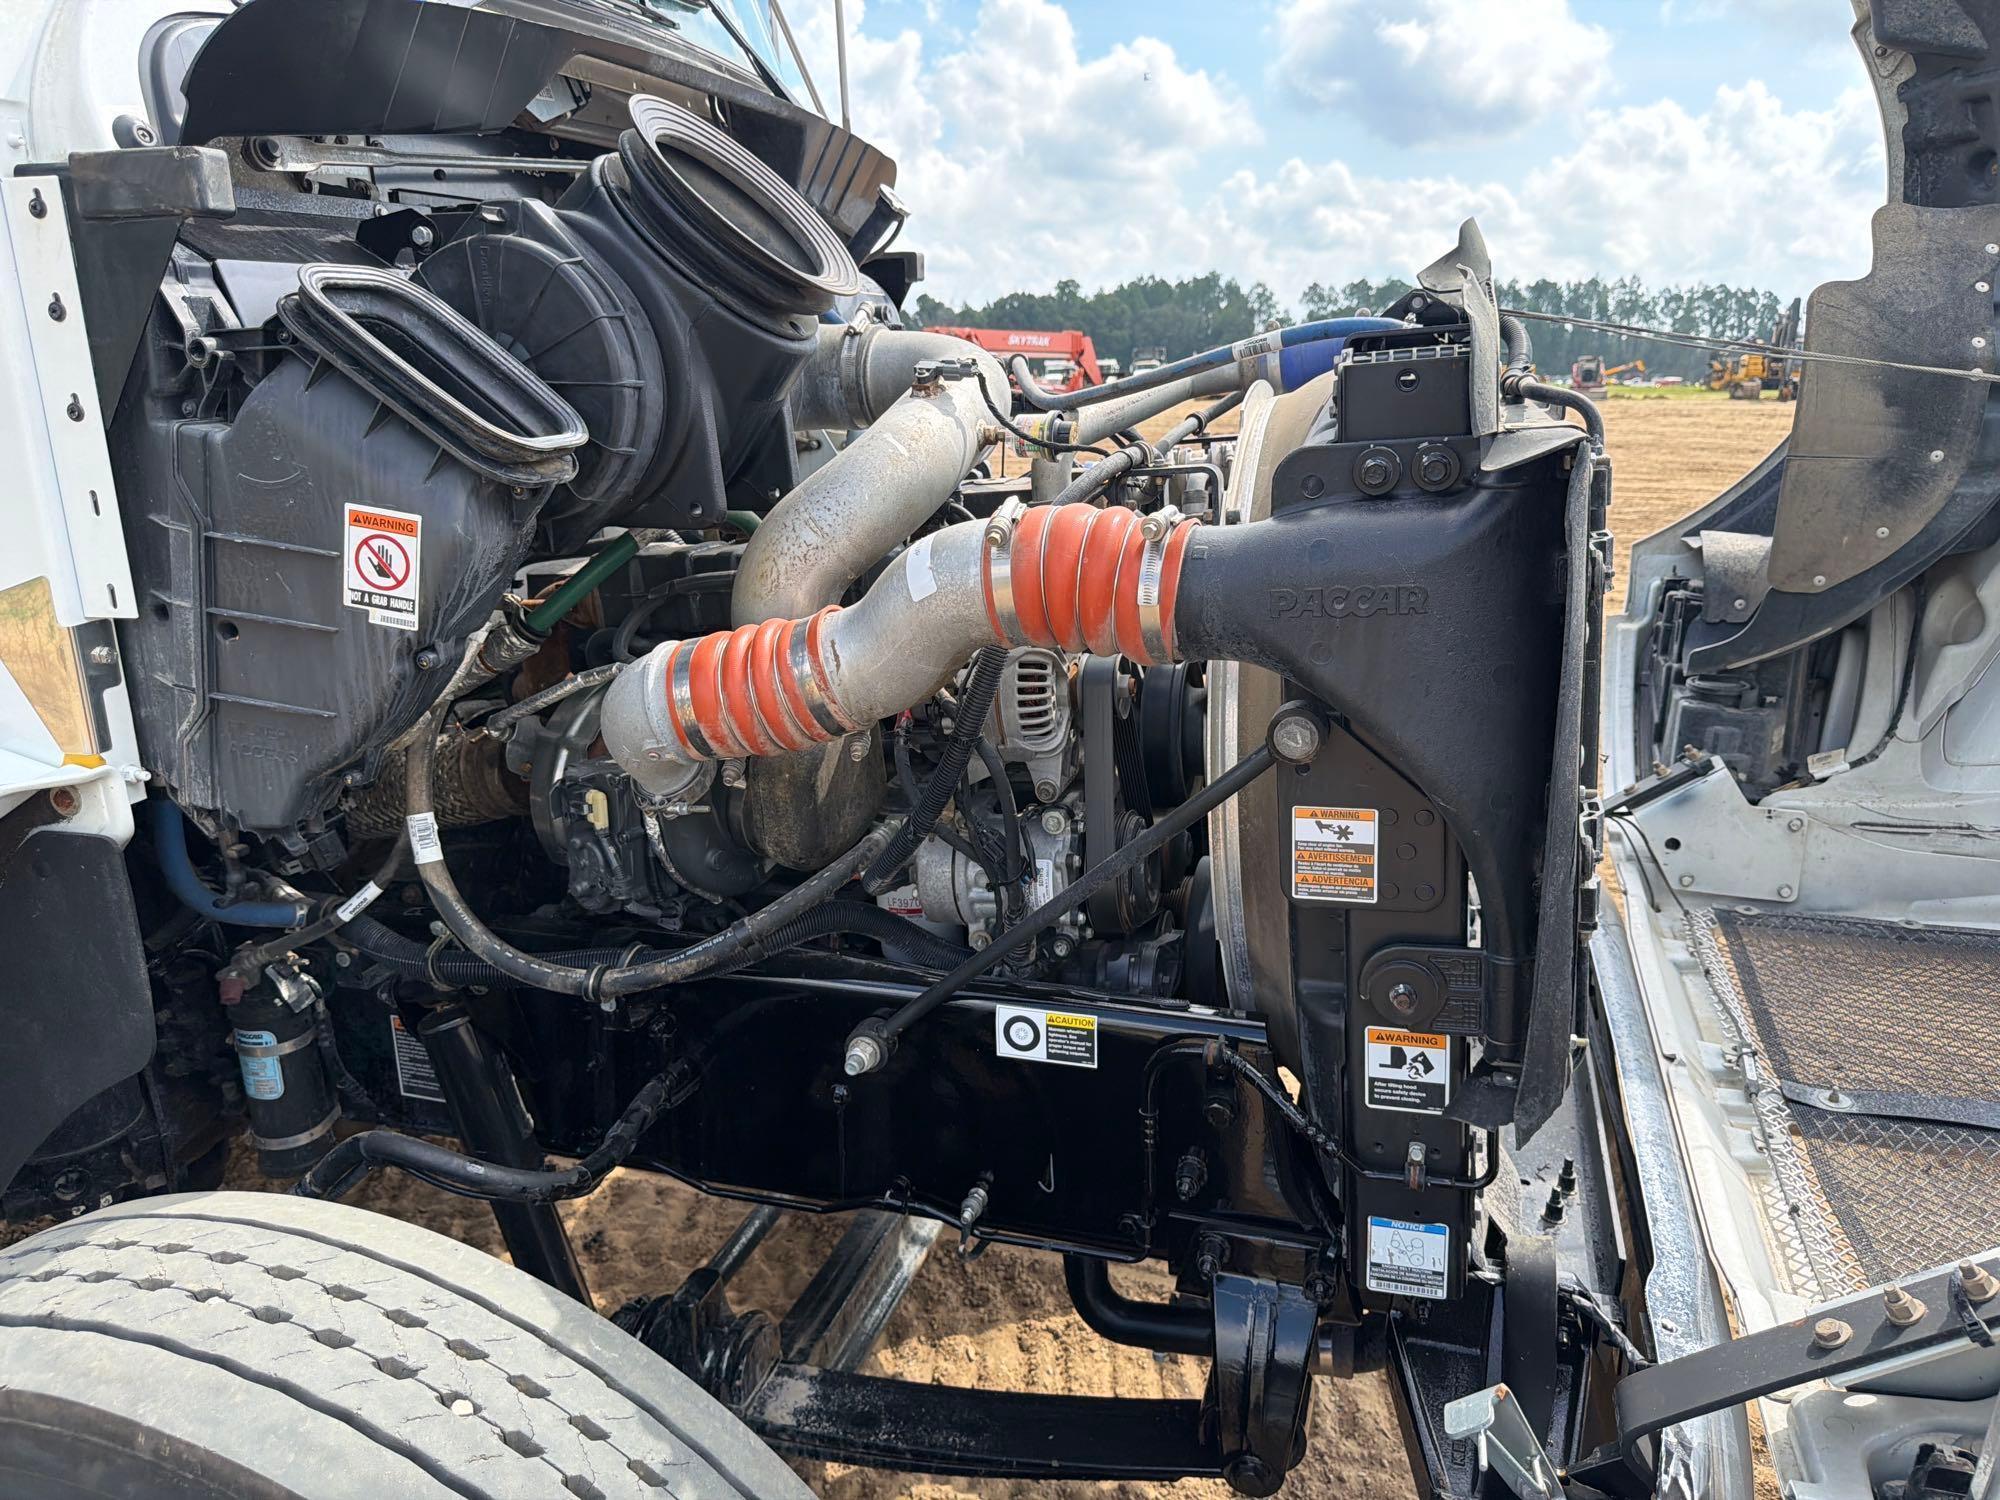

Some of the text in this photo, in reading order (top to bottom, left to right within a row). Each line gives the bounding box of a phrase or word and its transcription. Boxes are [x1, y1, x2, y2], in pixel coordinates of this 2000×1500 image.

[1008, 334, 1050, 347] SKYTRAK
[362, 515, 414, 533] WARNING
[364, 593, 369, 603] A
[372, 595, 388, 606] GRAB
[390, 598, 414, 611] HANDLE
[1269, 585, 1429, 619] PACCAR
[1320, 810, 1360, 819] WARNING
[1308, 852, 1372, 863] AVERTISSEMENT
[1312, 876, 1368, 886] ADVERTENCIA
[887, 897, 921, 907] LF3970
[1055, 1018, 1094, 1028] CAUTION
[1385, 1033, 1438, 1045] WARNING
[1391, 1220, 1425, 1231] NOTICE
